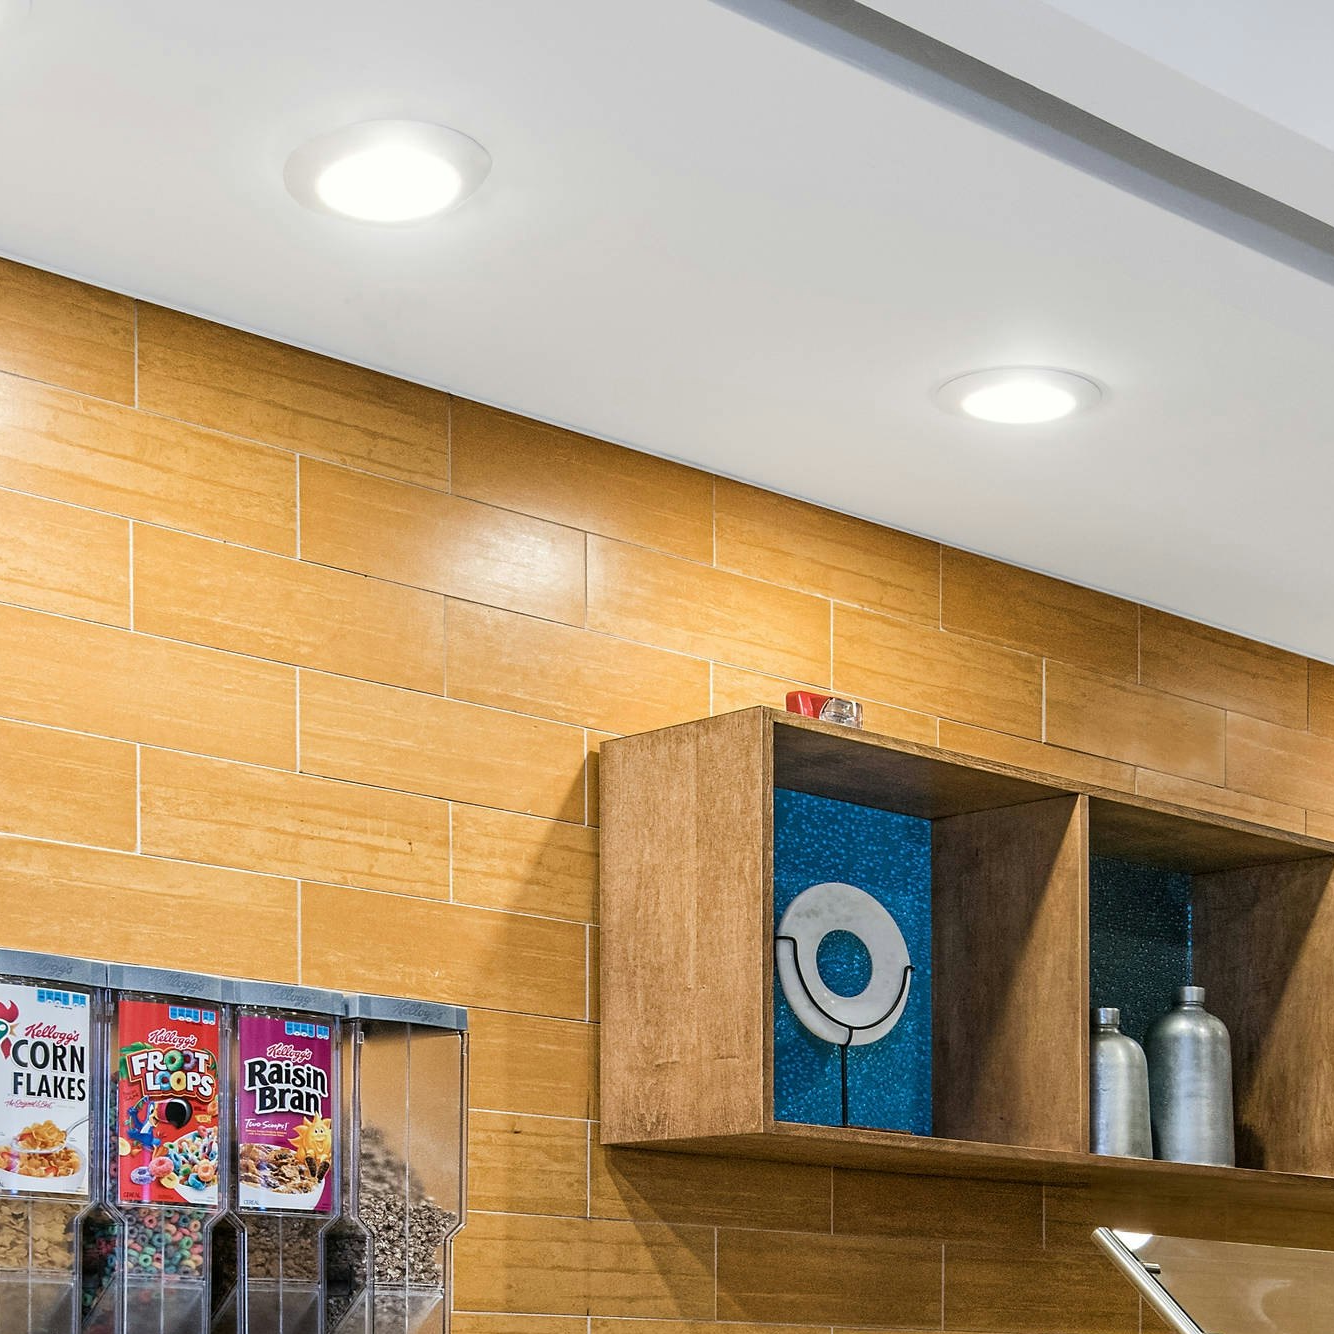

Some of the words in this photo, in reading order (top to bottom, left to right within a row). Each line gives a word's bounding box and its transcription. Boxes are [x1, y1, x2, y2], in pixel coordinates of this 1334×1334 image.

[25, 1022, 80, 1046] Kellogg's
[149, 1028, 197, 1049] Kellogg's
[11, 1039, 85, 1074] CORN
[131, 1050, 210, 1076] FROOT
[267, 1043, 312, 1062] Kellogg's
[13, 1071, 86, 1102] FLAKES
[146, 1071, 214, 1097] LOOPS
[247, 1060, 327, 1095] Raisin
[258, 1086, 320, 1113] Bran
[245, 1119, 261, 1128] Two
